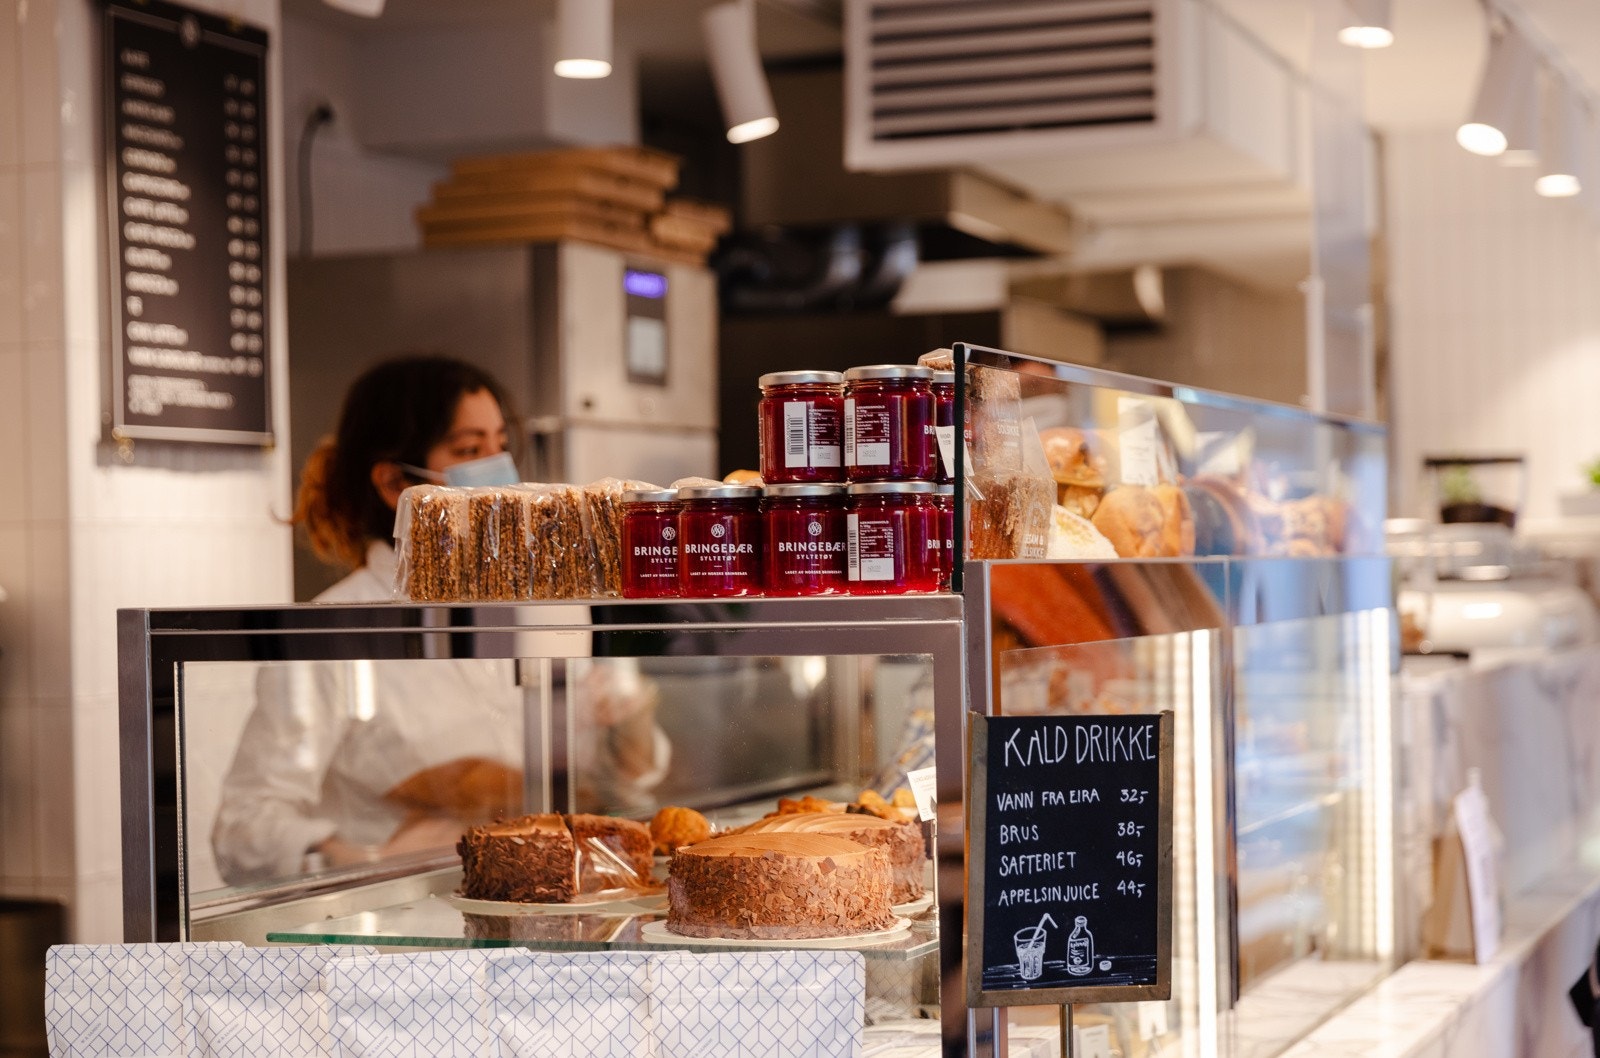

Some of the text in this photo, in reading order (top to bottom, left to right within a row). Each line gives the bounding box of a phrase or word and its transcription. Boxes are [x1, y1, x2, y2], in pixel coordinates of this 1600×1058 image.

[634, 546, 678, 556] BRINGE
[685, 543, 754, 554] BRINGEBÆR
[778, 541, 846, 552] BRINGEBÆR
[1005, 725, 1156, 767] KALD DRIKKE
[997, 791, 1034, 811] VANN
[1042, 791, 1066, 807] FRA
[1069, 788, 1101, 804] EIRA
[1000, 824, 1039, 845] BRUS
[999, 851, 1077, 877] SAFTERIET
[998, 882, 1100, 907] APPELSINJUICE
